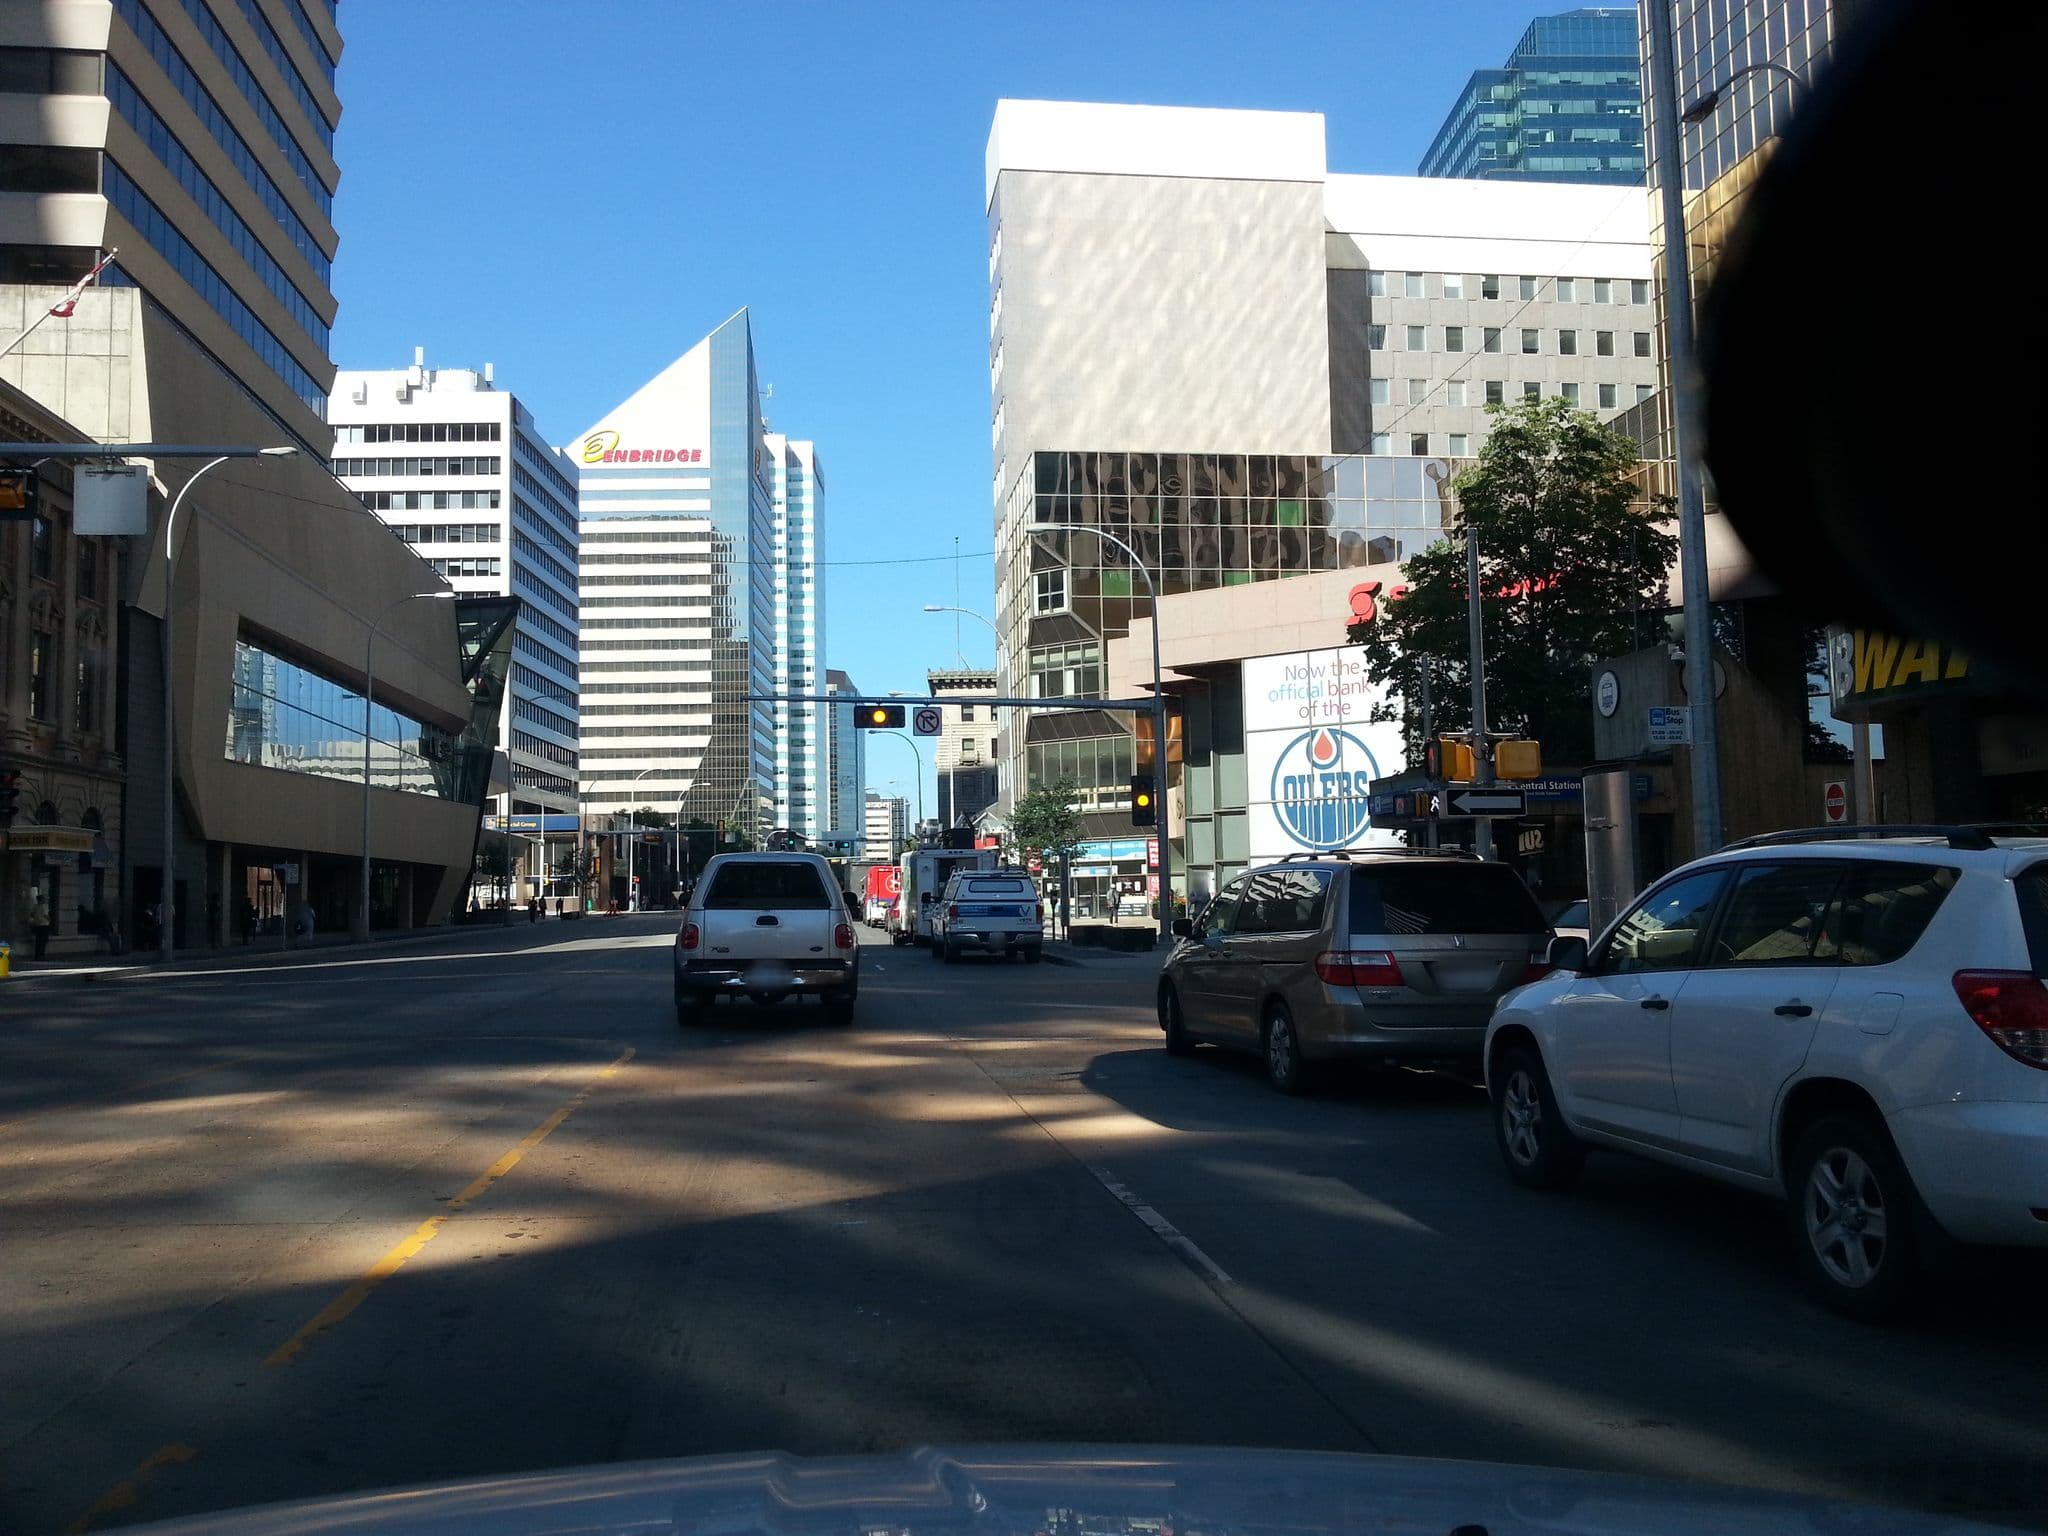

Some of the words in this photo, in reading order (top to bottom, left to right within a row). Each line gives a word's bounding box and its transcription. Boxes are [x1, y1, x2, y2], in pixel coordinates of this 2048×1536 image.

[603, 449, 702, 463] ENBRIDGE
[1285, 665, 1326, 682] Now
[1330, 659, 1360, 677] the
[1268, 680, 1324, 703] official
[1327, 677, 1372, 698] bank
[1299, 702, 1318, 719] of
[1324, 700, 1351, 717] the
[1666, 708, 1680, 716] Bus
[1666, 716, 1684, 726] Stop
[1549, 780, 1581, 790] Station
